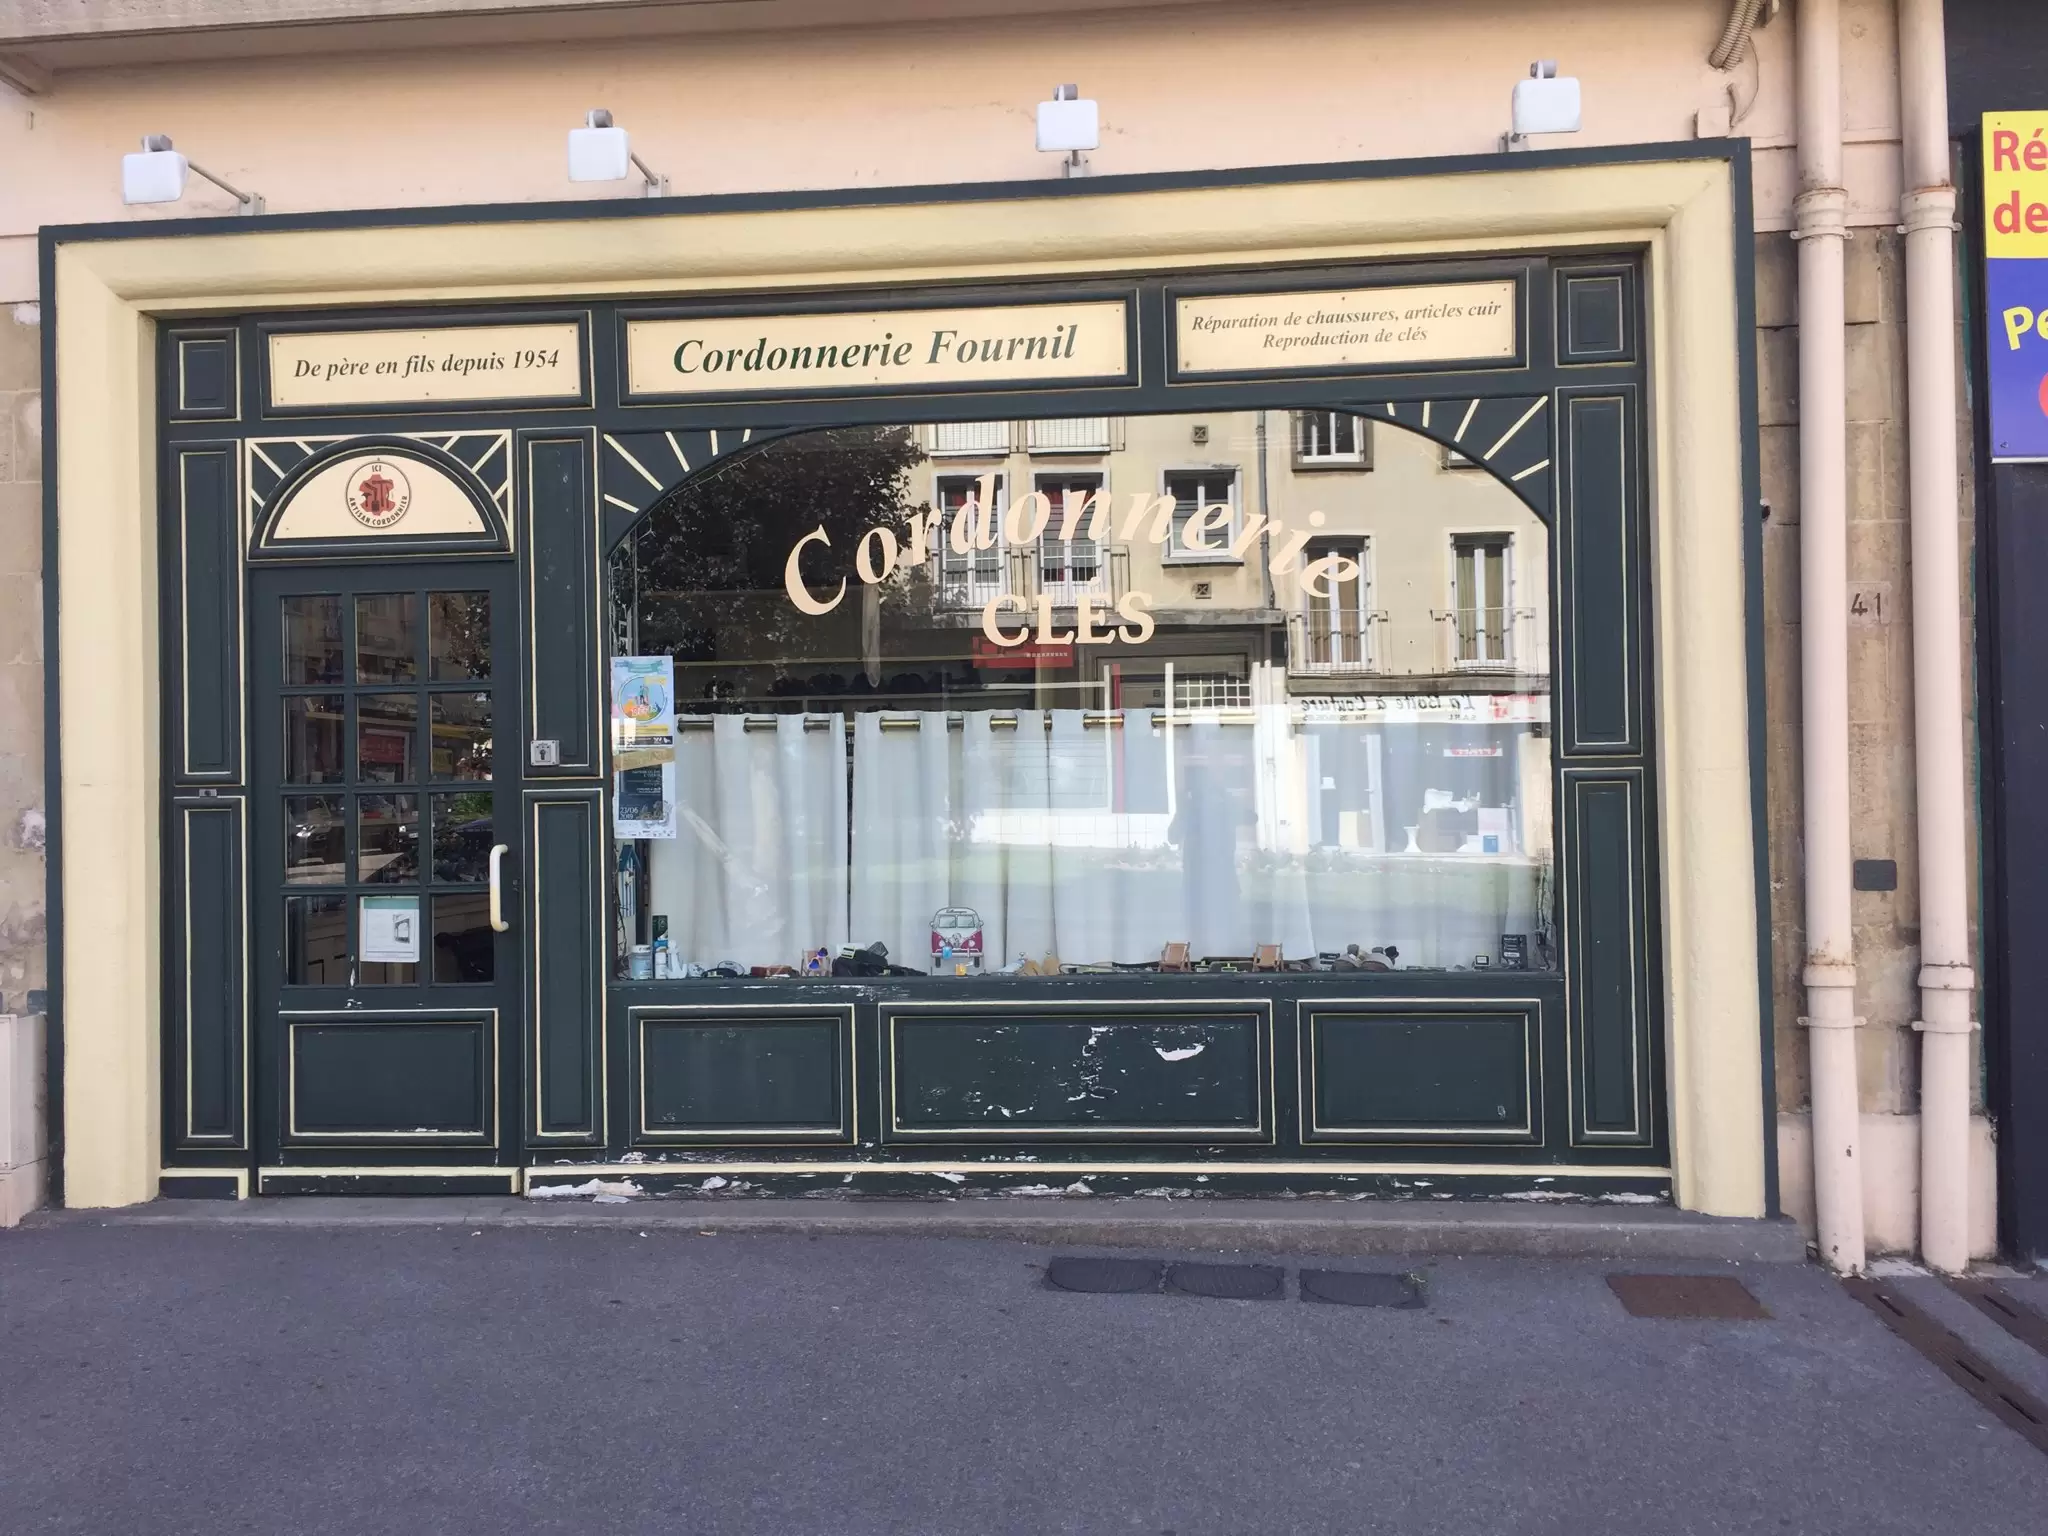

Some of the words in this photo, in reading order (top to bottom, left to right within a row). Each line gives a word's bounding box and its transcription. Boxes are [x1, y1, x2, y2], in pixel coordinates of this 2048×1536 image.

[1992, 127, 2048, 172] Ré
[1191, 312, 1278, 334] Réparation
[1283, 311, 1303, 326] de
[1306, 309, 1400, 325] chaussures,
[1404, 303, 1464, 320] articles
[1467, 300, 1503, 317] cuir
[673, 330, 913, 375] Cordonnerie
[924, 323, 1079, 366] Fournil
[1262, 330, 1370, 352] Reproduction
[1374, 327, 1394, 343] de
[1397, 325, 1429, 342] clés
[294, 359, 321, 377] De
[325, 357, 369, 381] père
[375, 361, 398, 374] en
[402, 354, 435, 378] fils
[441, 352, 505, 376] depuis
[513, 349, 559, 369] 1954
[371, 465, 382, 473] ICI
[349, 497, 371, 524] ARTISAN
[372, 495, 408, 525] CORDONNIER
[783, 472, 1361, 616] Cordonnerie
[981, 576, 1156, 647] CLÉS
[1850, 592, 1882, 619] 41
